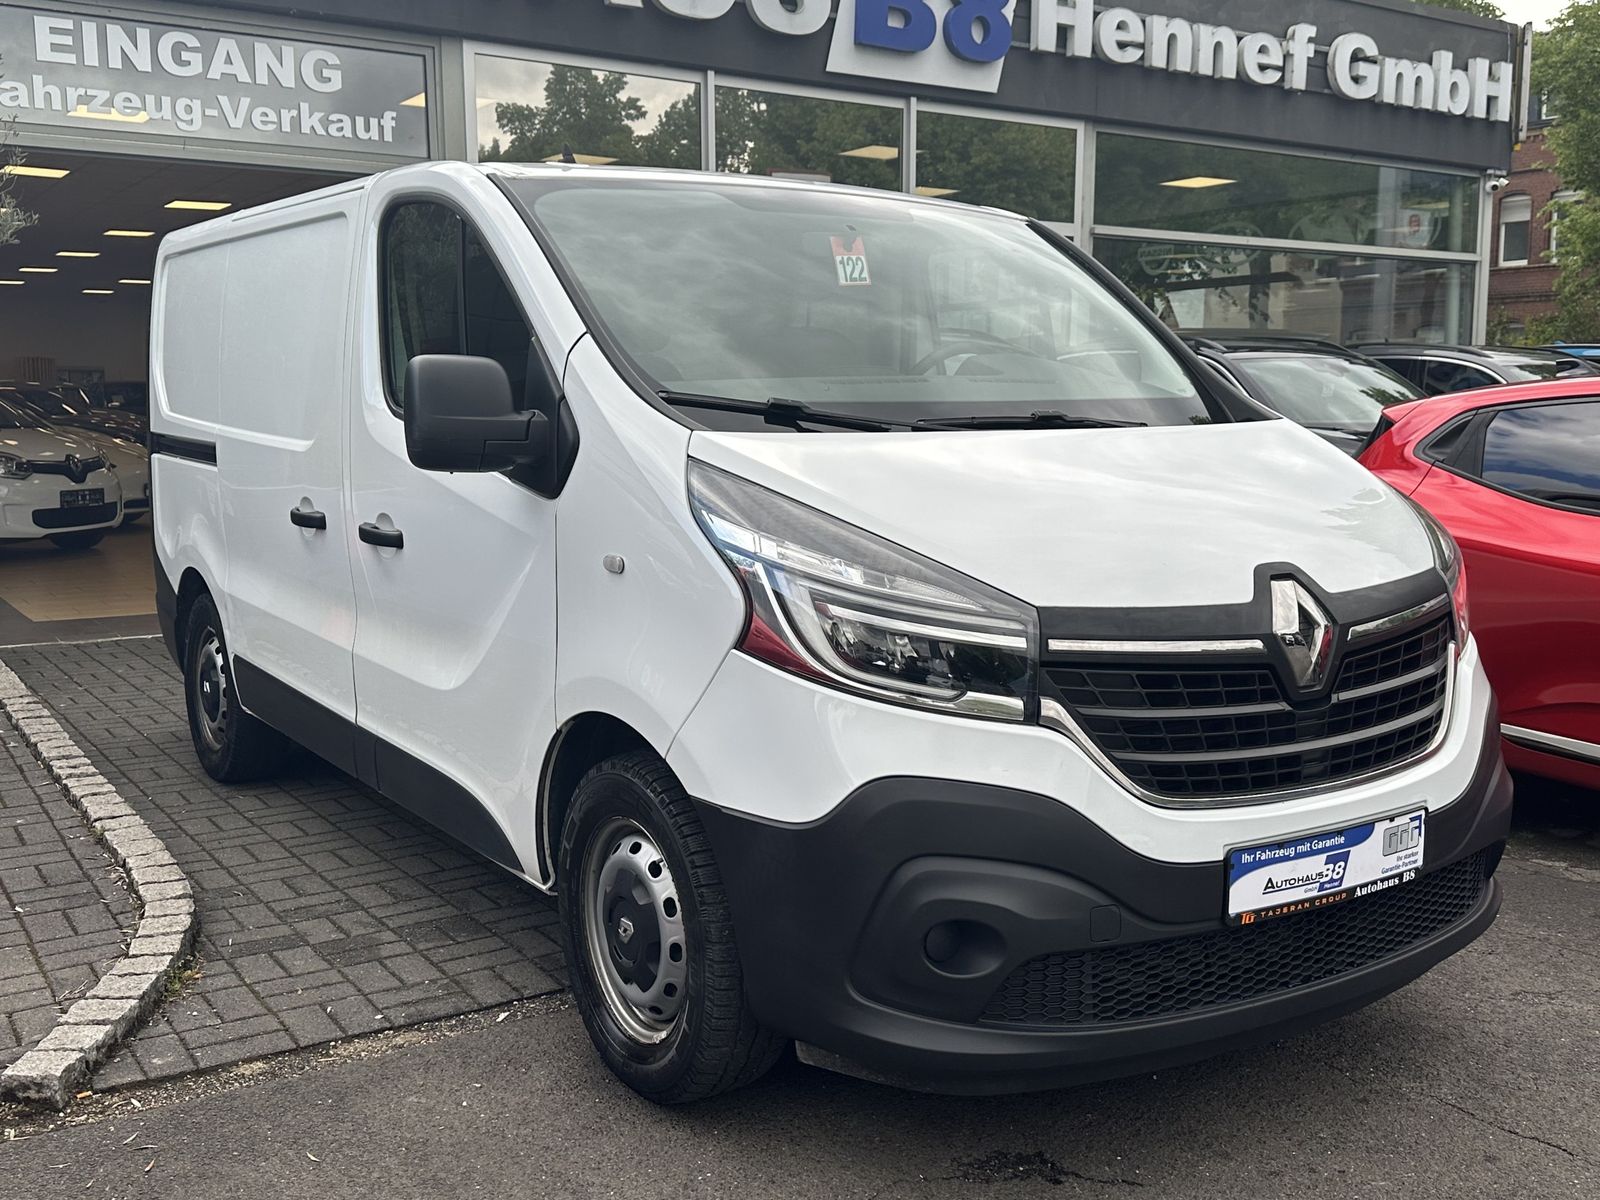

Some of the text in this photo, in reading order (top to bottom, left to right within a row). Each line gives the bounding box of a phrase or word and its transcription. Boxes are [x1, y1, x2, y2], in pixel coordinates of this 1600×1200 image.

[33, 15, 343, 93] EINGANG
[1030, 0, 1317, 92] Hennef
[1327, 32, 1512, 122] GmbH
[0, 75, 397, 143] ahrzeug-Verkauf
[839, 256, 867, 283] 122
[1241, 835, 1345, 864] Ihr Fahrzeug mit Garantie
[1353, 869, 1416, 898] Autohaus B8
[1314, 893, 1347, 906] GROUP
